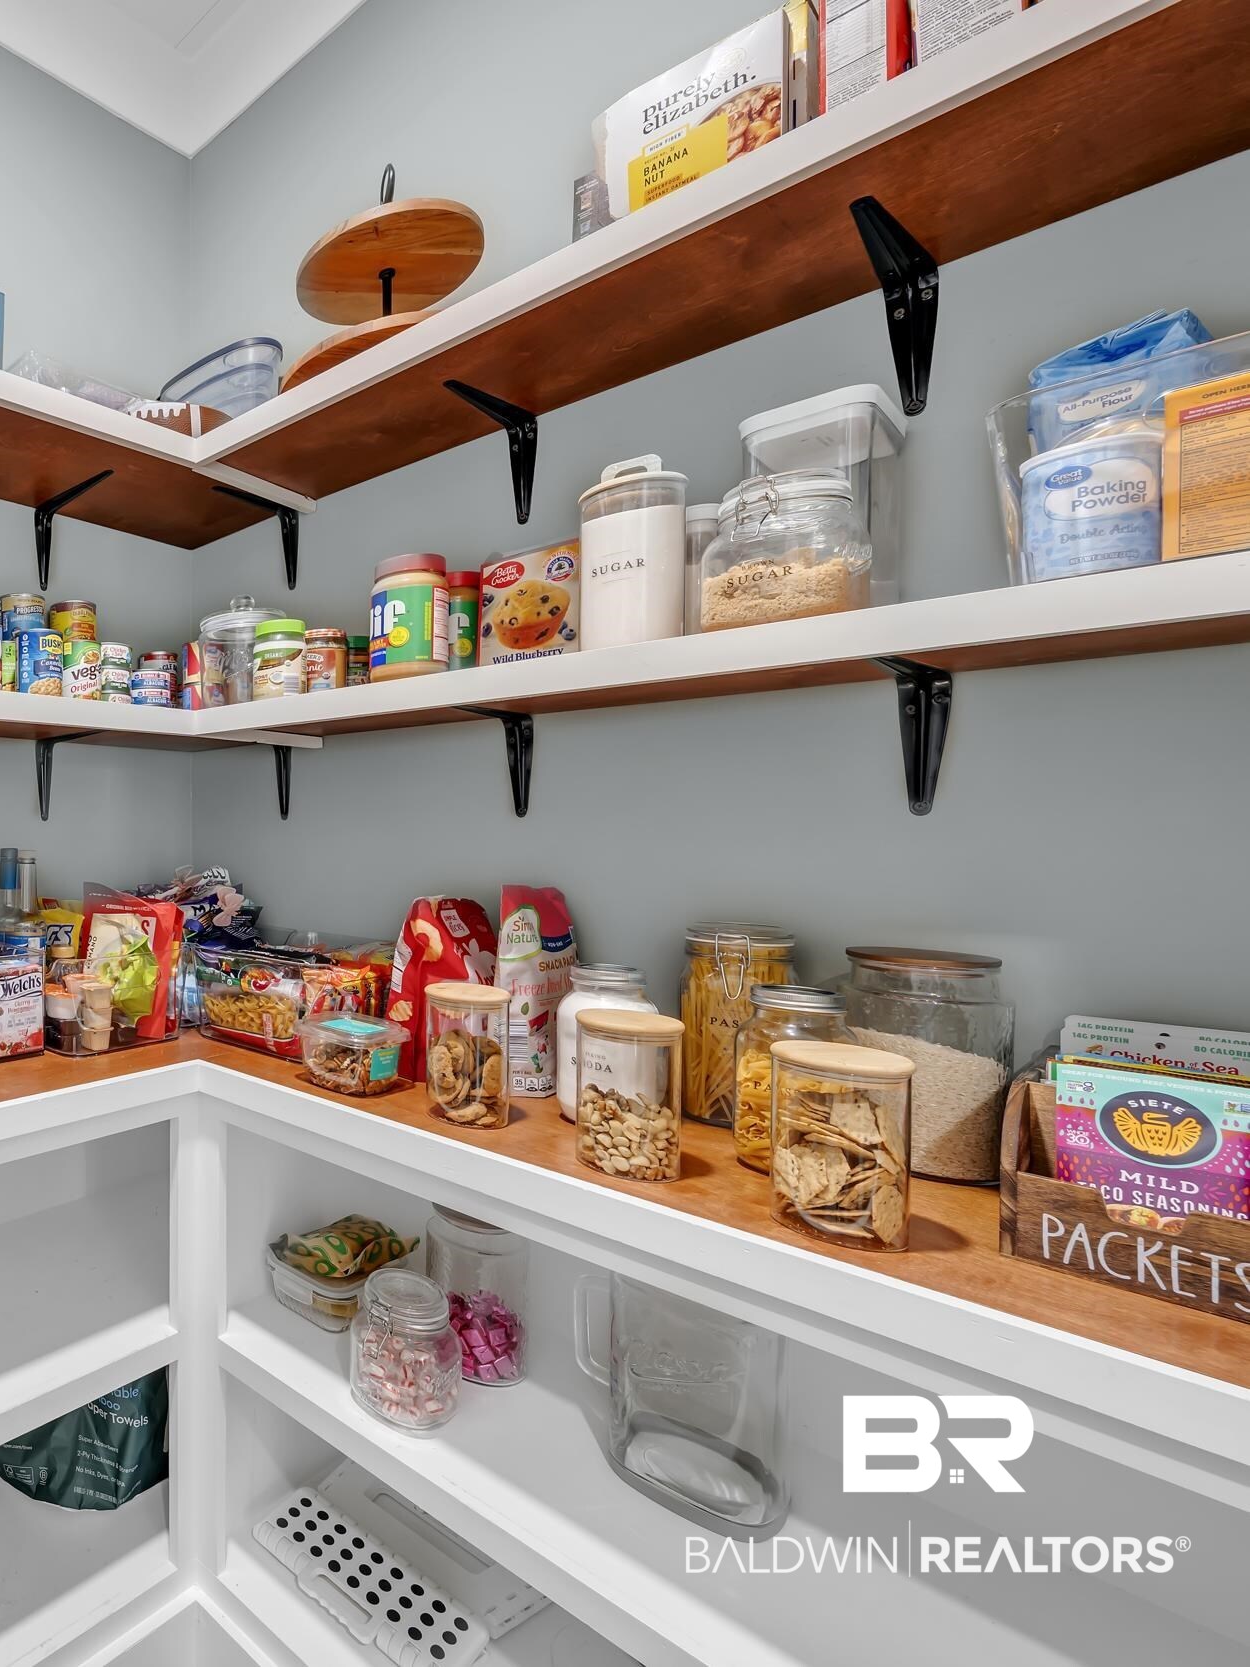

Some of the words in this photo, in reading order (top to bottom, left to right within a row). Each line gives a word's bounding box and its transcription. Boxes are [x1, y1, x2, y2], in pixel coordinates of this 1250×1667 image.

[642, 71, 717, 123] purely
[643, 147, 689, 177] BANANA
[644, 169, 665, 187] NUT
[647, 175, 681, 196] SUPERFOOD
[1062, 386, 1133, 414] All-Purpose
[1101, 393, 1134, 410] Flour
[1201, 388, 1227, 399] OPEN
[1052, 468, 1083, 483] Great
[1077, 478, 1147, 500] Baking
[1070, 490, 1148, 513] Powder
[1059, 528, 1105, 545] Double
[1110, 524, 1147, 537] Acting
[495, 564, 518, 579] Betty
[591, 557, 647, 579] SUGAR
[741, 557, 776, 571] BROWN
[491, 573, 521, 587] Crocker
[726, 564, 794, 590] SUGAR
[493, 653, 514, 665] Wild
[516, 647, 564, 661] Blueberry
[71, 680, 98, 693] Original
[538, 960, 563, 972] SNACK
[0, 975, 42, 997] Welch's
[510, 978, 545, 997] Freeze
[1072, 1031, 1089, 1040] 14G
[1090, 1033, 1130, 1044] PROTEIN
[1194, 1045, 1208, 1053] 80
[1110, 1050, 1185, 1069] Chicken
[1201, 1060, 1239, 1076] Sea
[514, 1078, 523, 1086] 35
[1061, 1069, 1086, 1077] GREAT
[1088, 1071, 1104, 1079] FOR
[1105, 1073, 1142, 1084] GROUND
[1127, 1098, 1187, 1116] SIETE
[1118, 1169, 1200, 1195] MILD
[1041, 1212, 1250, 1314] PACKETS
[110, 1413, 149, 1428] Towels
[78, 1434, 92, 1444] Super
[77, 1450, 90, 1460] 2-Ply
